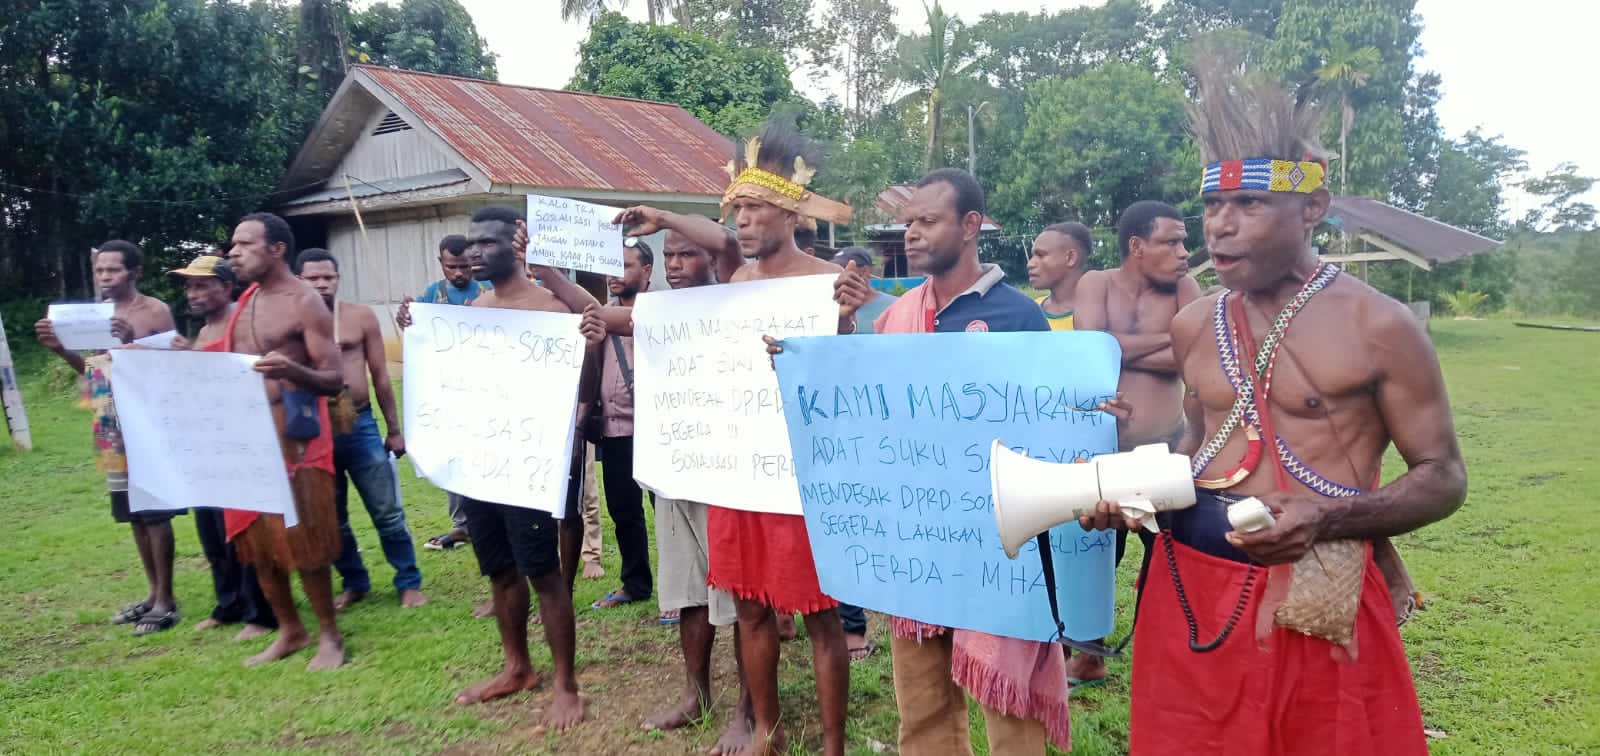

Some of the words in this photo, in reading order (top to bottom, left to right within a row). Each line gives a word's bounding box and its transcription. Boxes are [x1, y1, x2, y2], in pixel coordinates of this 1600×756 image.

[575, 204, 595, 216] TRA
[645, 321, 691, 345] KAMI
[667, 355, 704, 377] ADAT
[798, 383, 890, 426] KAMI
[907, 381, 1114, 427] MASYARAKAT
[812, 435, 864, 466] ADAT
[879, 435, 947, 470] SUKU
[751, 453, 796, 481] PER
[801, 482, 892, 508] MENDESAK
[820, 511, 887, 538] SEGERA
[898, 519, 983, 549] LAKUKAN
[845, 544, 943, 585] PERDA
[982, 560, 1059, 595] MHA
